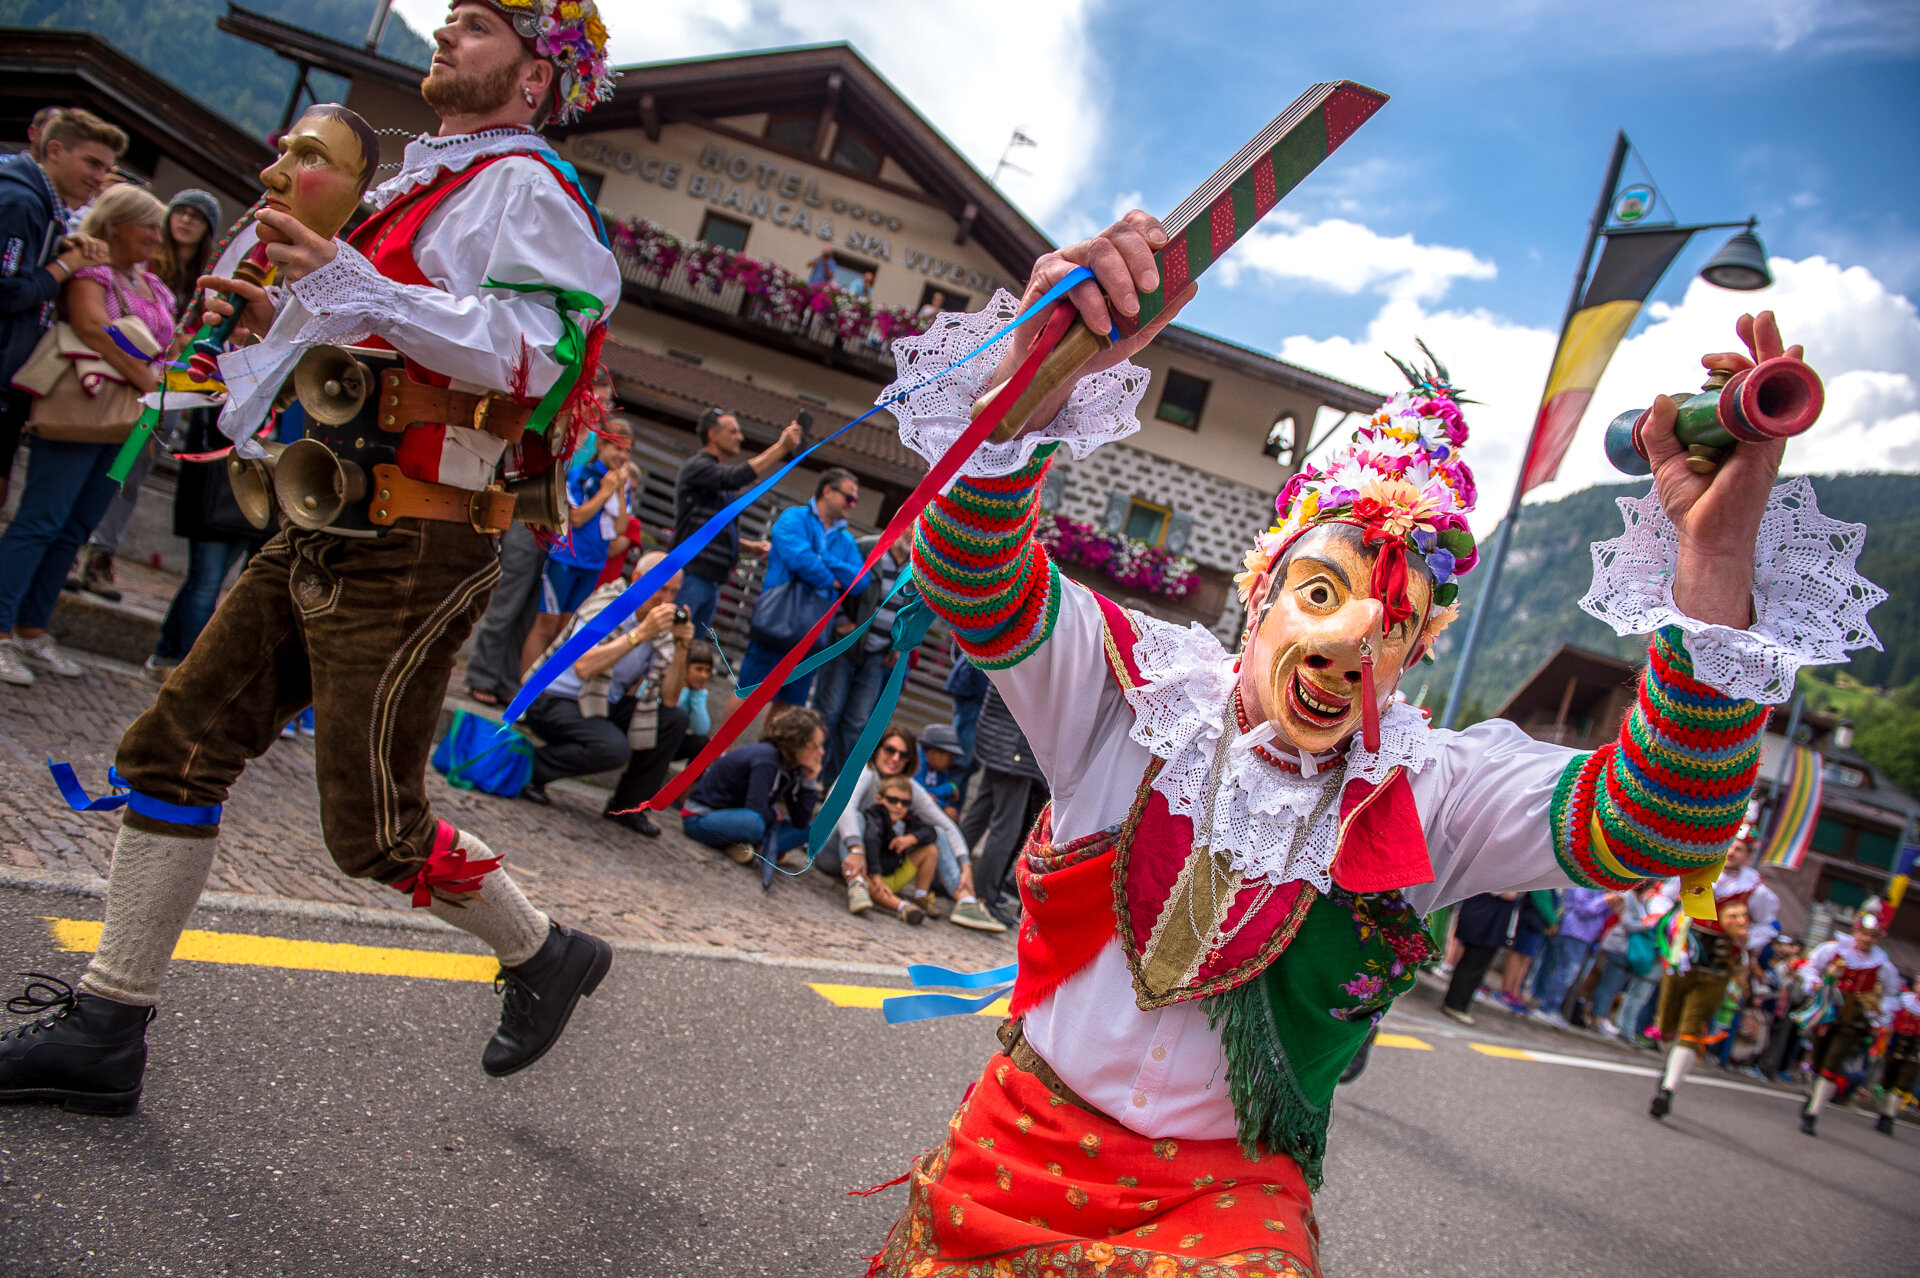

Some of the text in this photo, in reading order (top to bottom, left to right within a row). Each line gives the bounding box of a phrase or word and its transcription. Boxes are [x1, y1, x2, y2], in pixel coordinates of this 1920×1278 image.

[574, 137, 680, 188] CROCE
[688, 174, 811, 234] BIANCA
[817, 220, 833, 241] &
[848, 230, 891, 261] SPA
[701, 145, 822, 207] HOTEL
